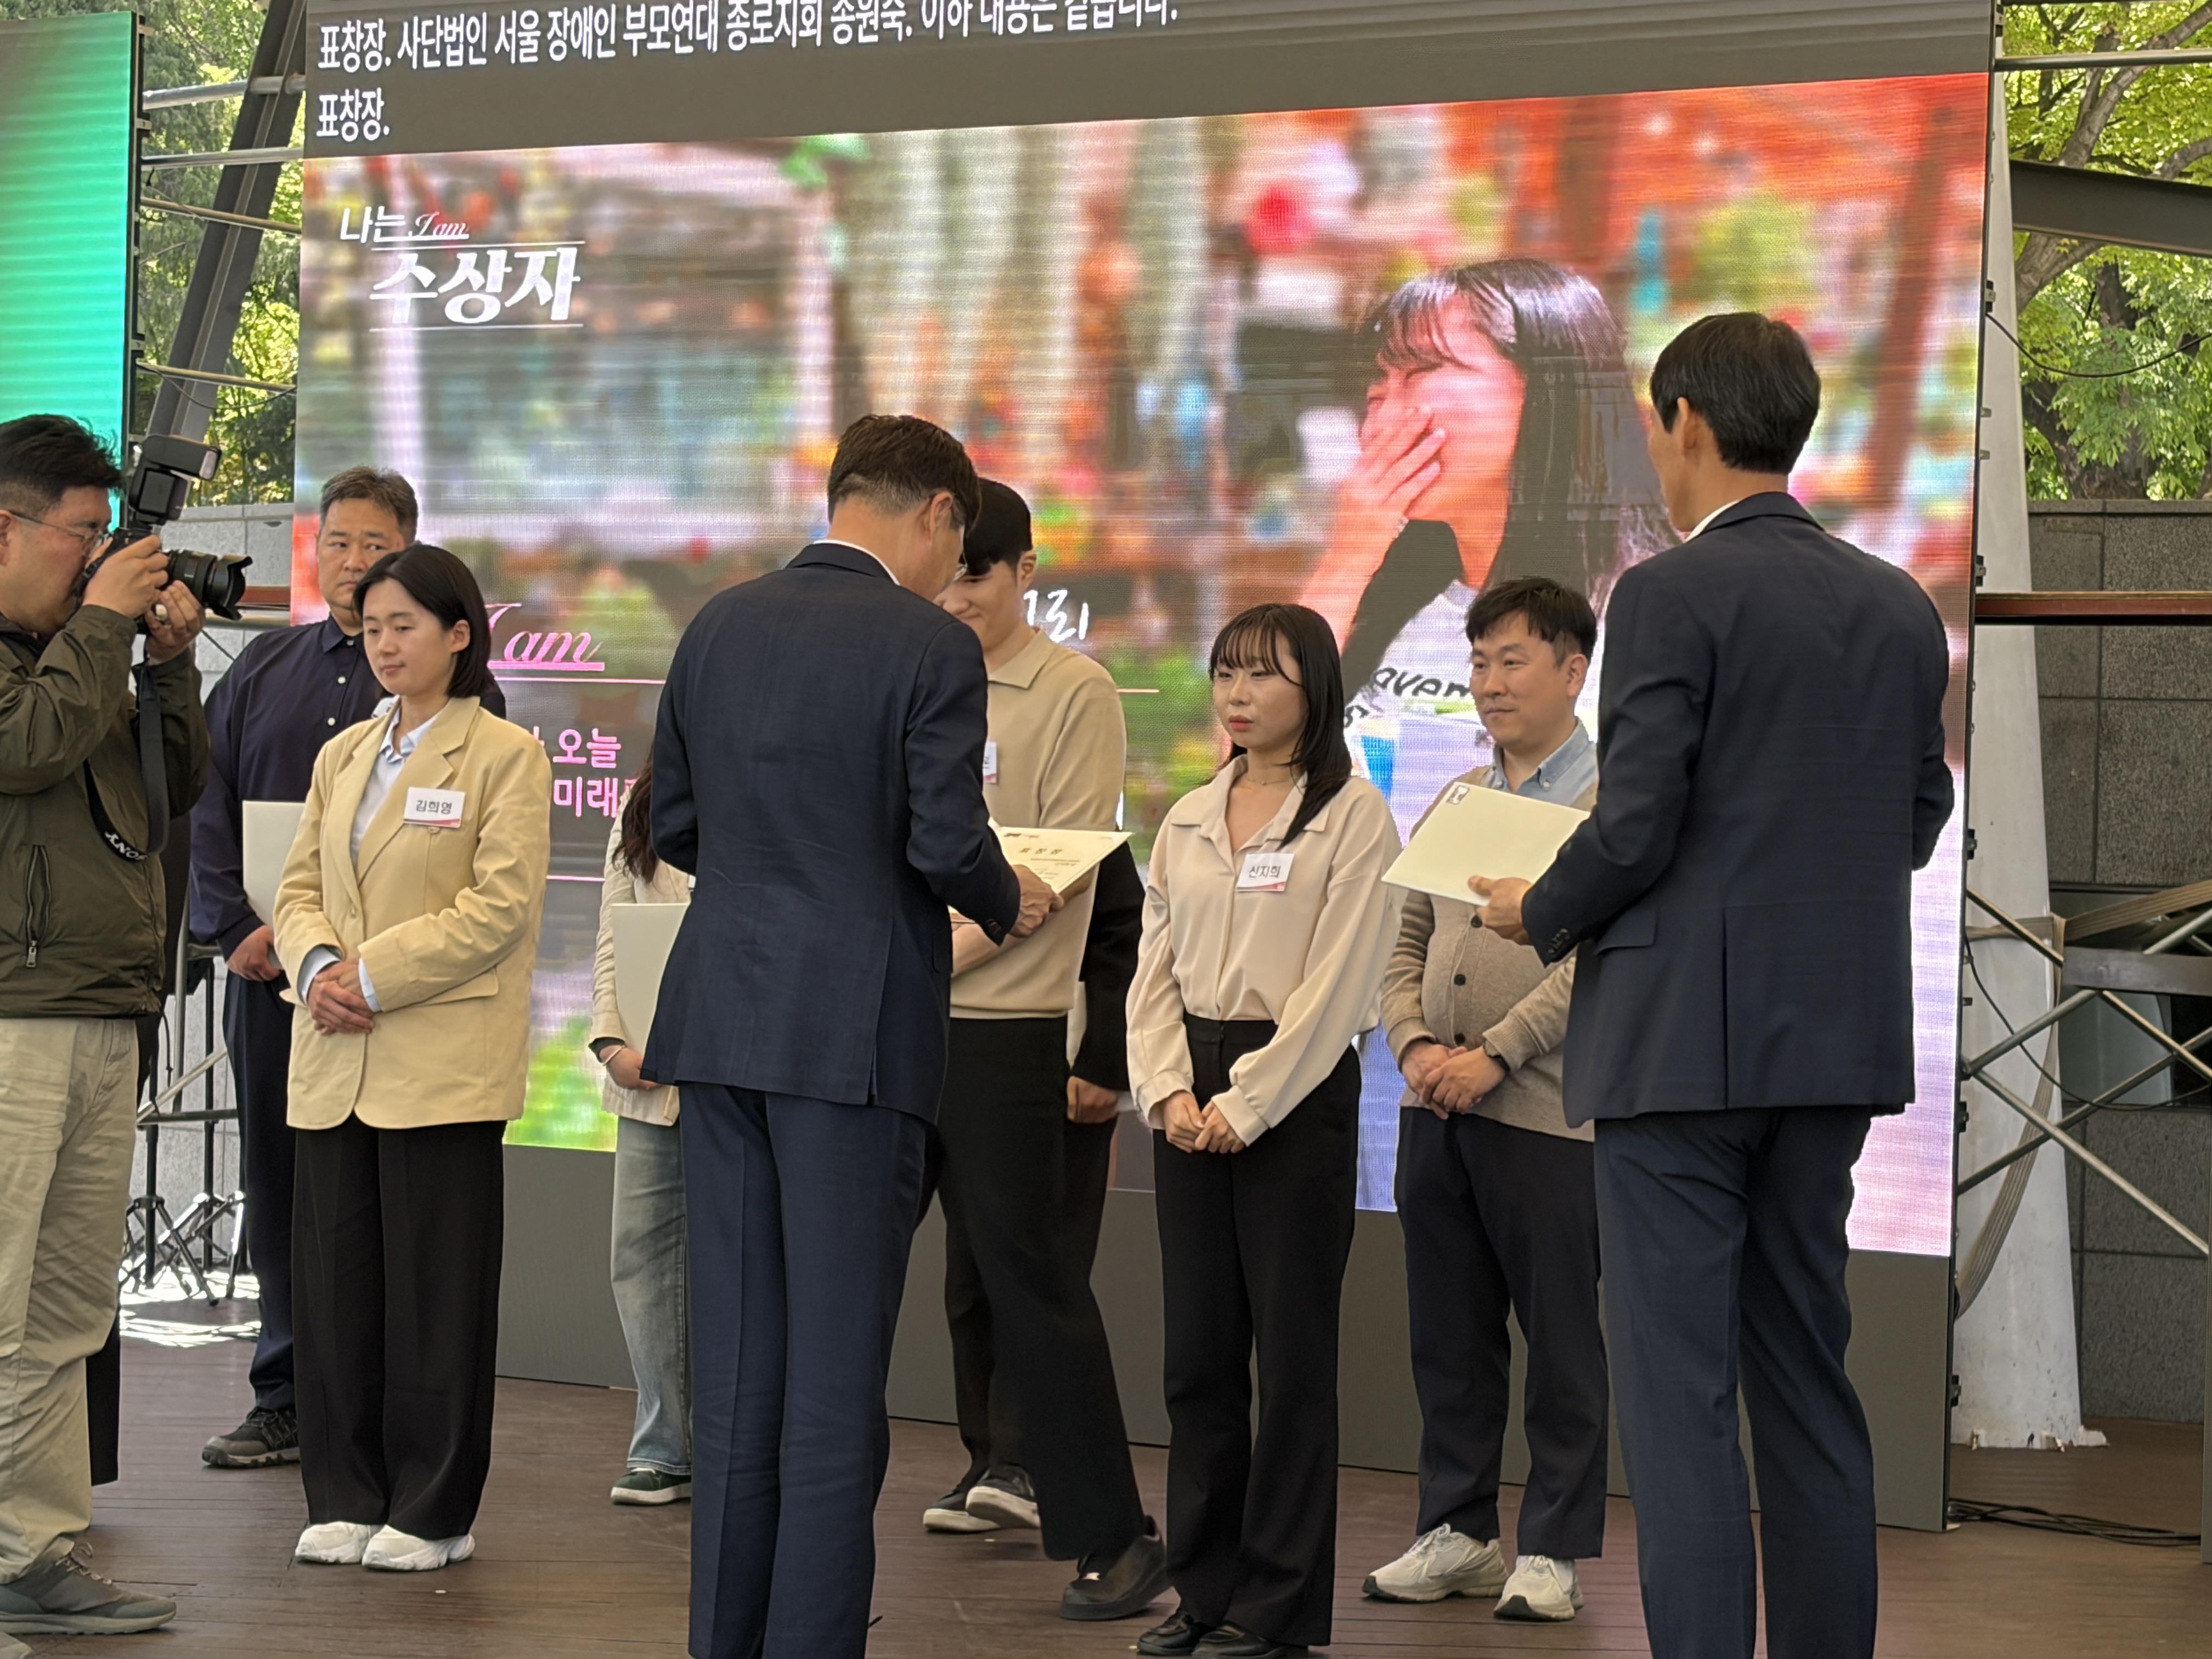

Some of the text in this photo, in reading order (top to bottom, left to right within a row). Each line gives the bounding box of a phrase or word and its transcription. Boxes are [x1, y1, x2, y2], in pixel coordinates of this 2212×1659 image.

[318, 18, 391, 72] 표창장.
[397, 12, 487, 69] 사단법인
[494, 10, 541, 64] 서울
[546, 4, 616, 61] 장애인
[622, 0, 719, 57] 부모연대
[725, 0, 822, 51] 종로지회
[316, 87, 390, 142] 표창장.
[340, 206, 407, 242] 나는
[433, 223, 470, 237] am
[370, 247, 581, 324] 수상자
[553, 729, 622, 768] 오늘
[416, 800, 452, 814] 김희영
[554, 777, 636, 819] 미래
[1249, 866, 1281, 878] 신지희
